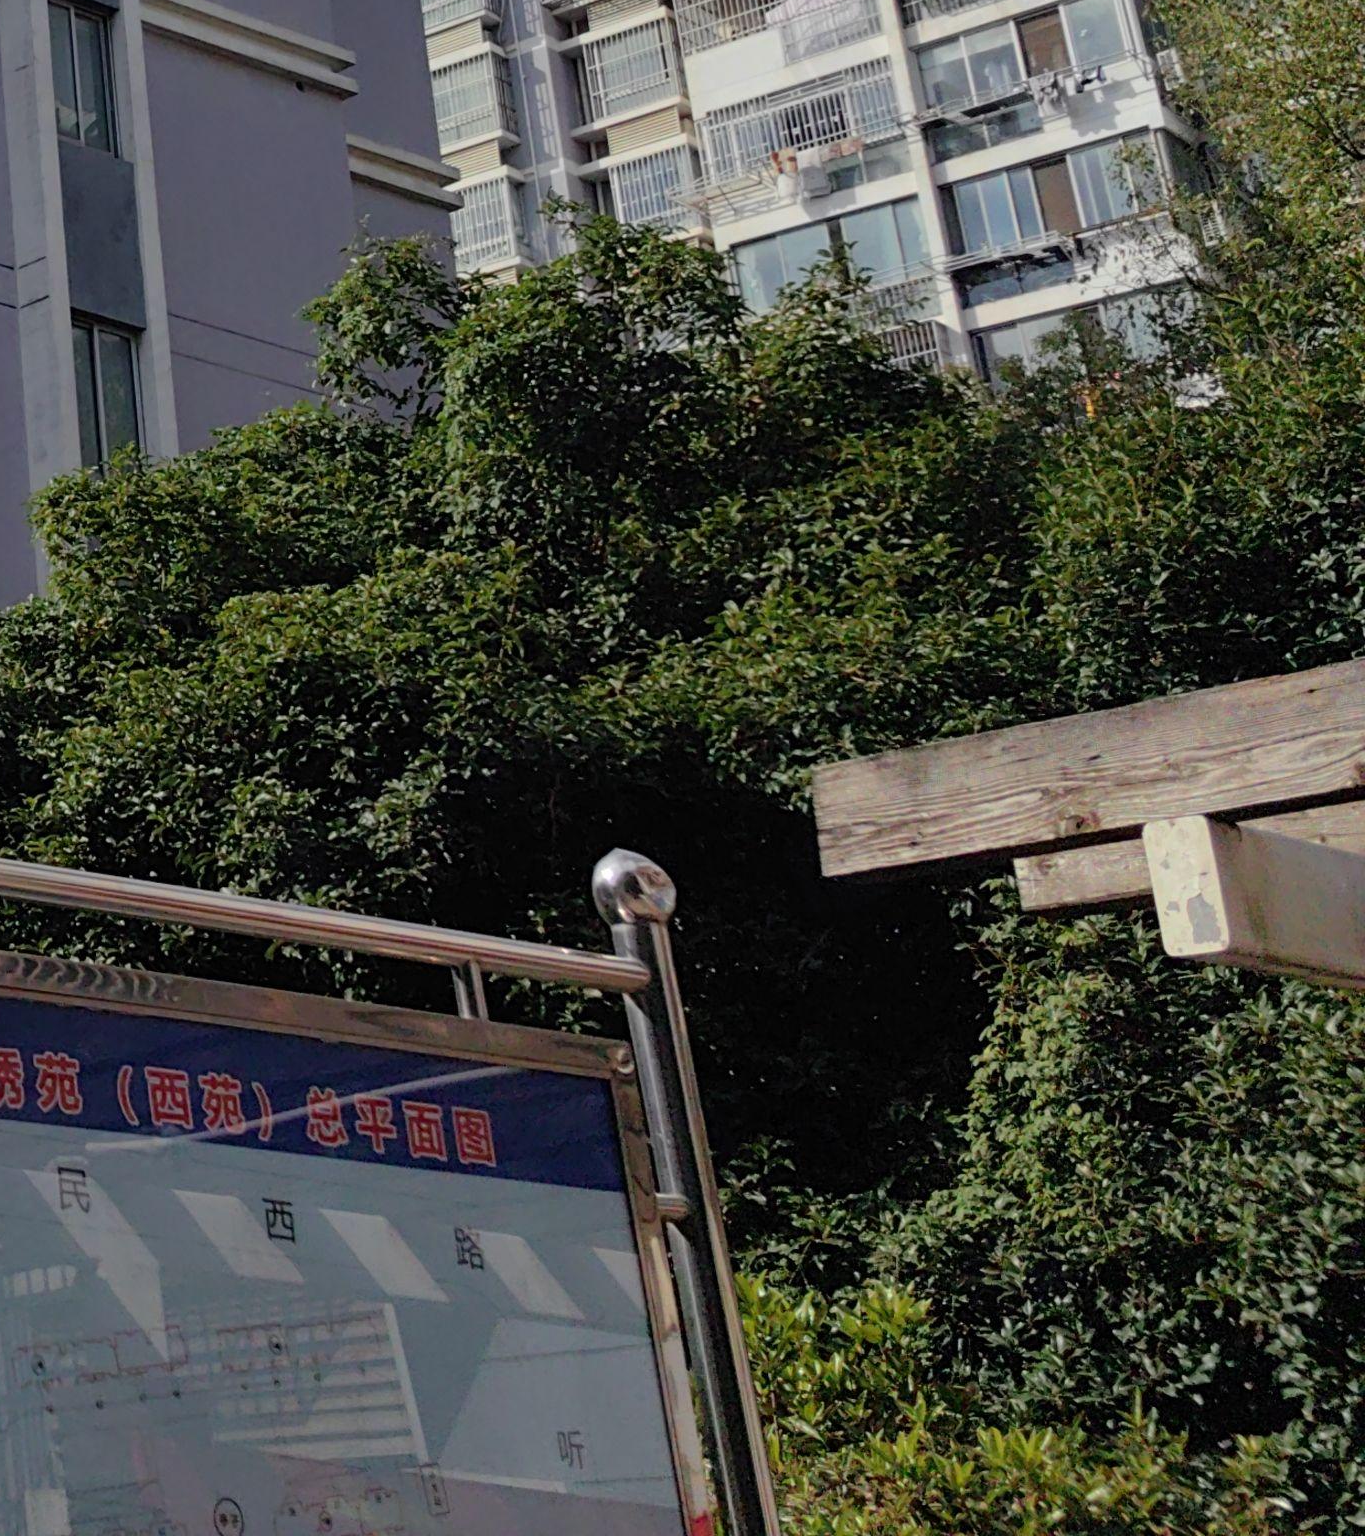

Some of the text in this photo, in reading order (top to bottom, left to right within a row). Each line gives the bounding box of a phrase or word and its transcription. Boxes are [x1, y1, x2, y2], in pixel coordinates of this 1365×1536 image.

[57, 1166, 92, 1214] 民
[261, 1196, 297, 1245] 西
[453, 1225, 485, 1271] 路
